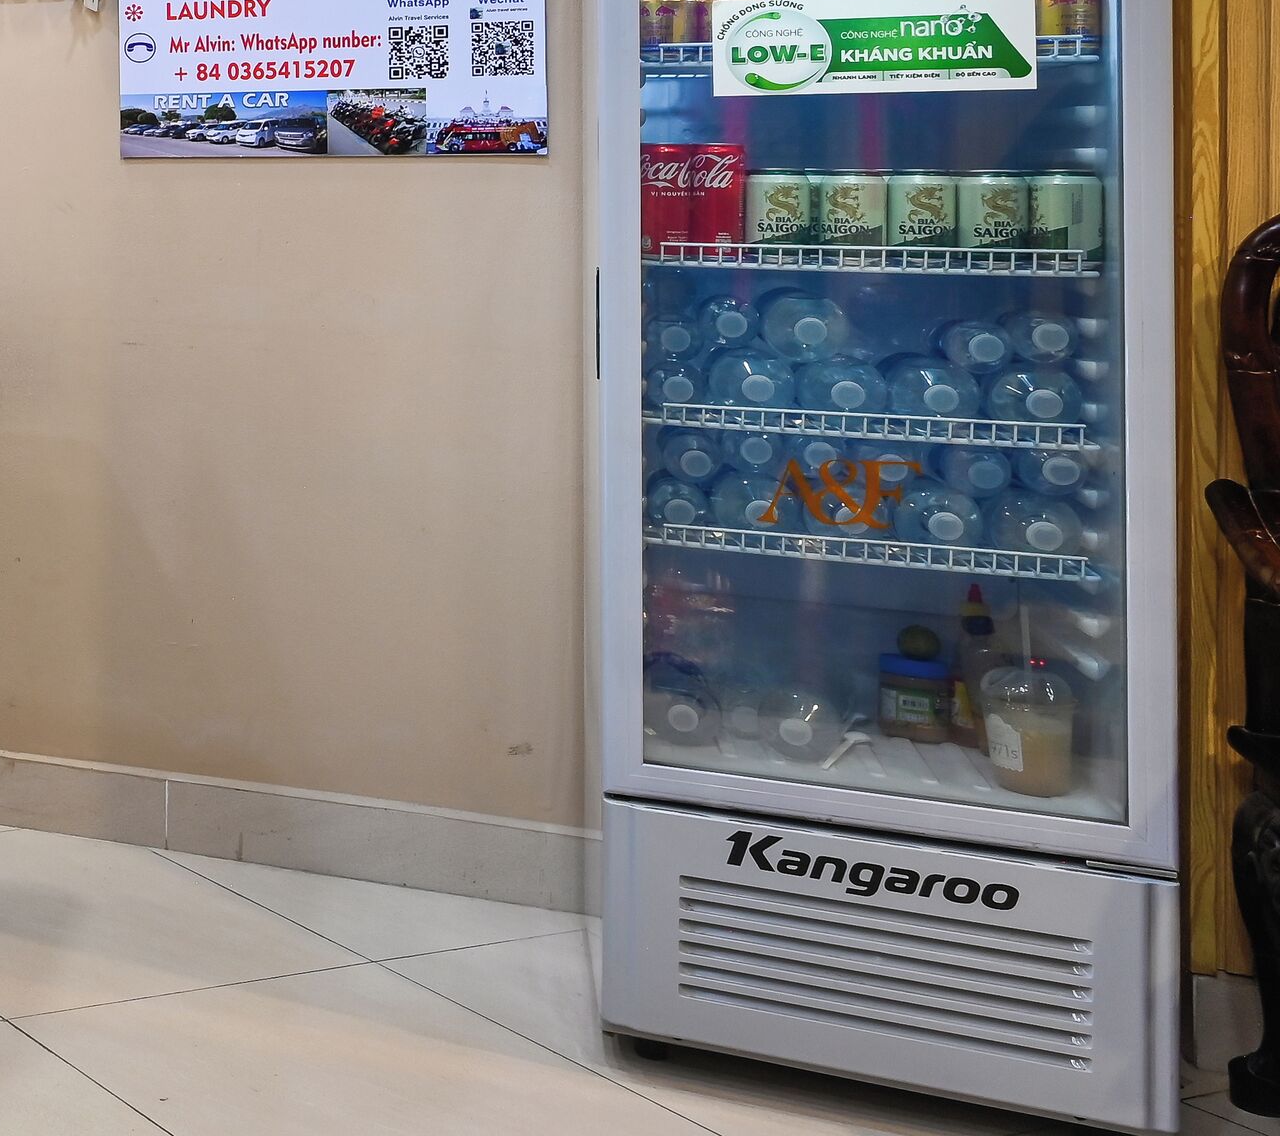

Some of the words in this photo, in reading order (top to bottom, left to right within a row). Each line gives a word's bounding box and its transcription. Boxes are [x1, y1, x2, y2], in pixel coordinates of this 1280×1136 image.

[745, 29, 773, 38] CÔNG
[840, 30, 869, 39] CÔNG
[900, 19, 964, 36] nano
[169, 35, 190, 54] Mr
[194, 34, 236, 53] Alvin:
[240, 32, 318, 55] WhatsApp
[323, 31, 383, 50] nunber:
[840, 45, 913, 63] KHÁNG
[918, 40, 993, 60] KHUẨN
[730, 43, 826, 64] LOW-E
[196, 62, 221, 82] 84
[227, 59, 356, 80] 0365415207
[153, 94, 212, 110] RENT
[217, 92, 235, 108] A
[242, 91, 290, 108] CAR
[757, 223, 809, 233] SAIGON
[899, 225, 951, 235] SAIGON
